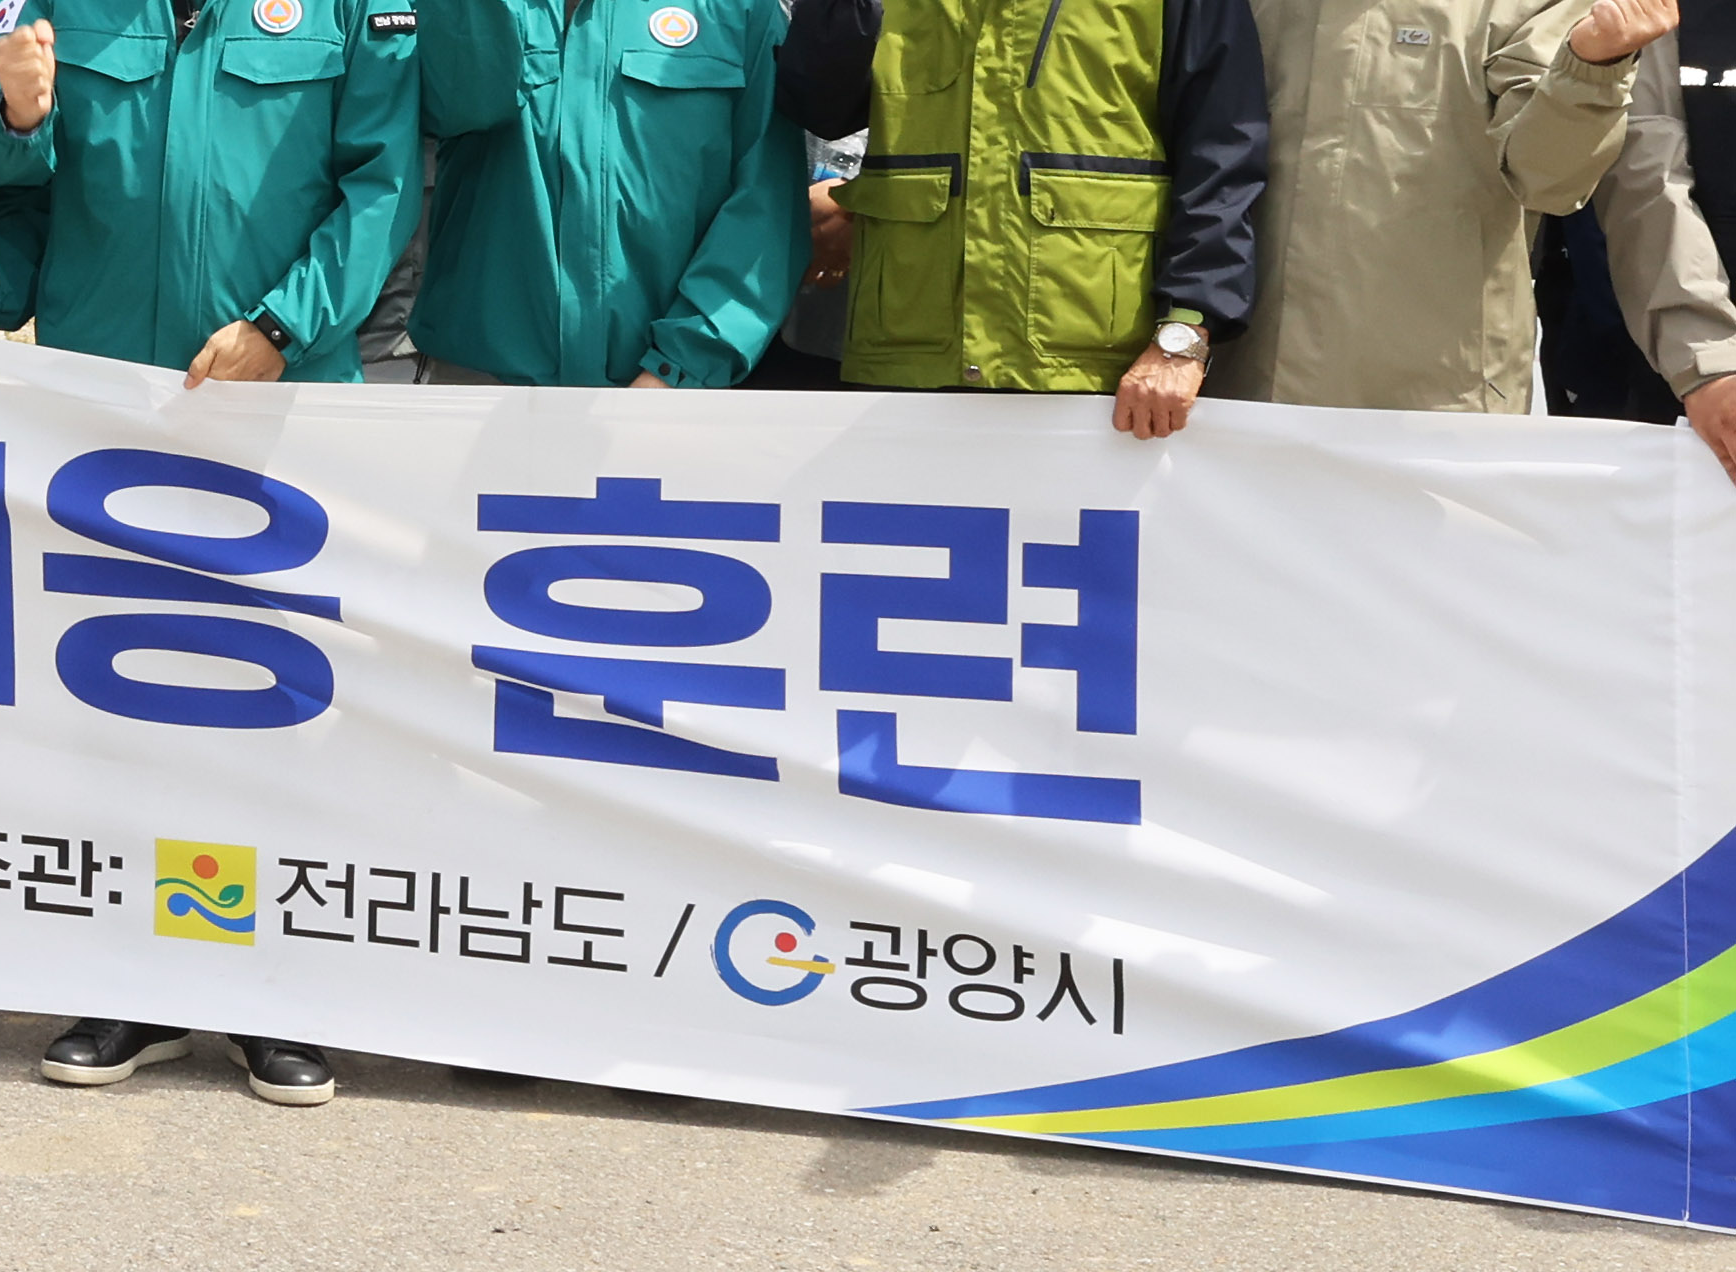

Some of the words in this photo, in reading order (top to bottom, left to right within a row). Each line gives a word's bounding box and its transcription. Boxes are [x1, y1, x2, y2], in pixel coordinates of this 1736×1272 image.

[1397, 28, 1430, 44] K2
[471, 478, 1141, 824] 훈련
[274, 856, 629, 973] 전라남도
[844, 920, 1126, 1035] 광양시
